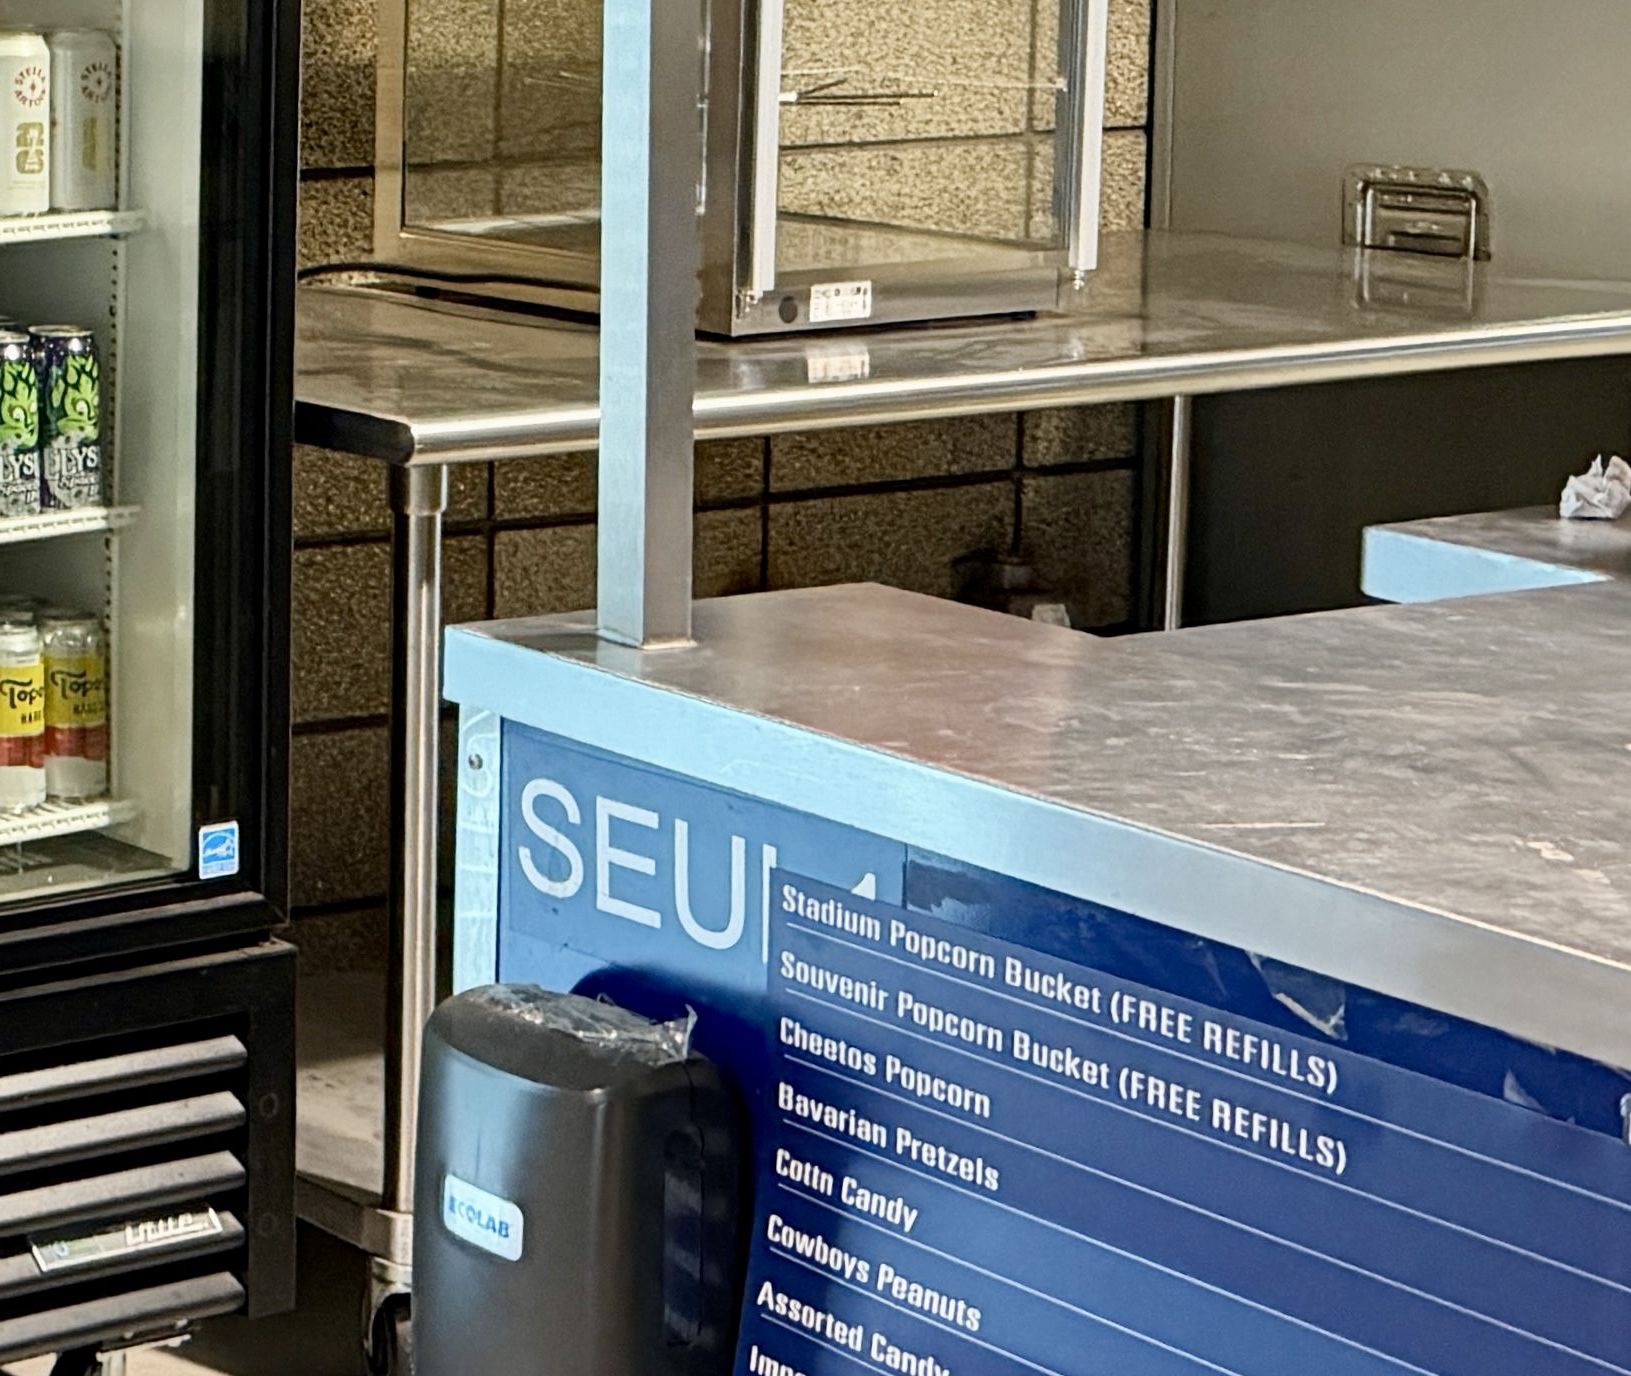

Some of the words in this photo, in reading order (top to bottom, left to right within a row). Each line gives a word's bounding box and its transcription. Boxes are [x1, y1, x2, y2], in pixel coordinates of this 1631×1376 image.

[781, 884, 881, 942] Stadium
[889, 918, 995, 979] Popcorn
[1004, 955, 1102, 1015] Bucket
[1110, 990, 1193, 1044] (FREE
[1202, 1020, 1338, 1095] REFILLS)
[779, 1017, 878, 1076] Cheetos
[885, 1054, 991, 1119] Popcorn
[780, 950, 889, 1012] Souvenir
[896, 990, 1004, 1053] Popcorn
[1012, 1029, 1110, 1090] Bucket
[1118, 1067, 1202, 1122] (FREE
[1211, 1097, 1347, 1176] REFILLS)
[775, 1147, 834, 1197] Cottn
[840, 1175, 919, 1234] Candy
[777, 1080, 888, 1149] Bavarian
[895, 1126, 1000, 1192] Pretzels
[756, 1280, 864, 1353] Assorted
[766, 1213, 871, 1284] Cowboys
[876, 1263, 982, 1332] Peanuts
